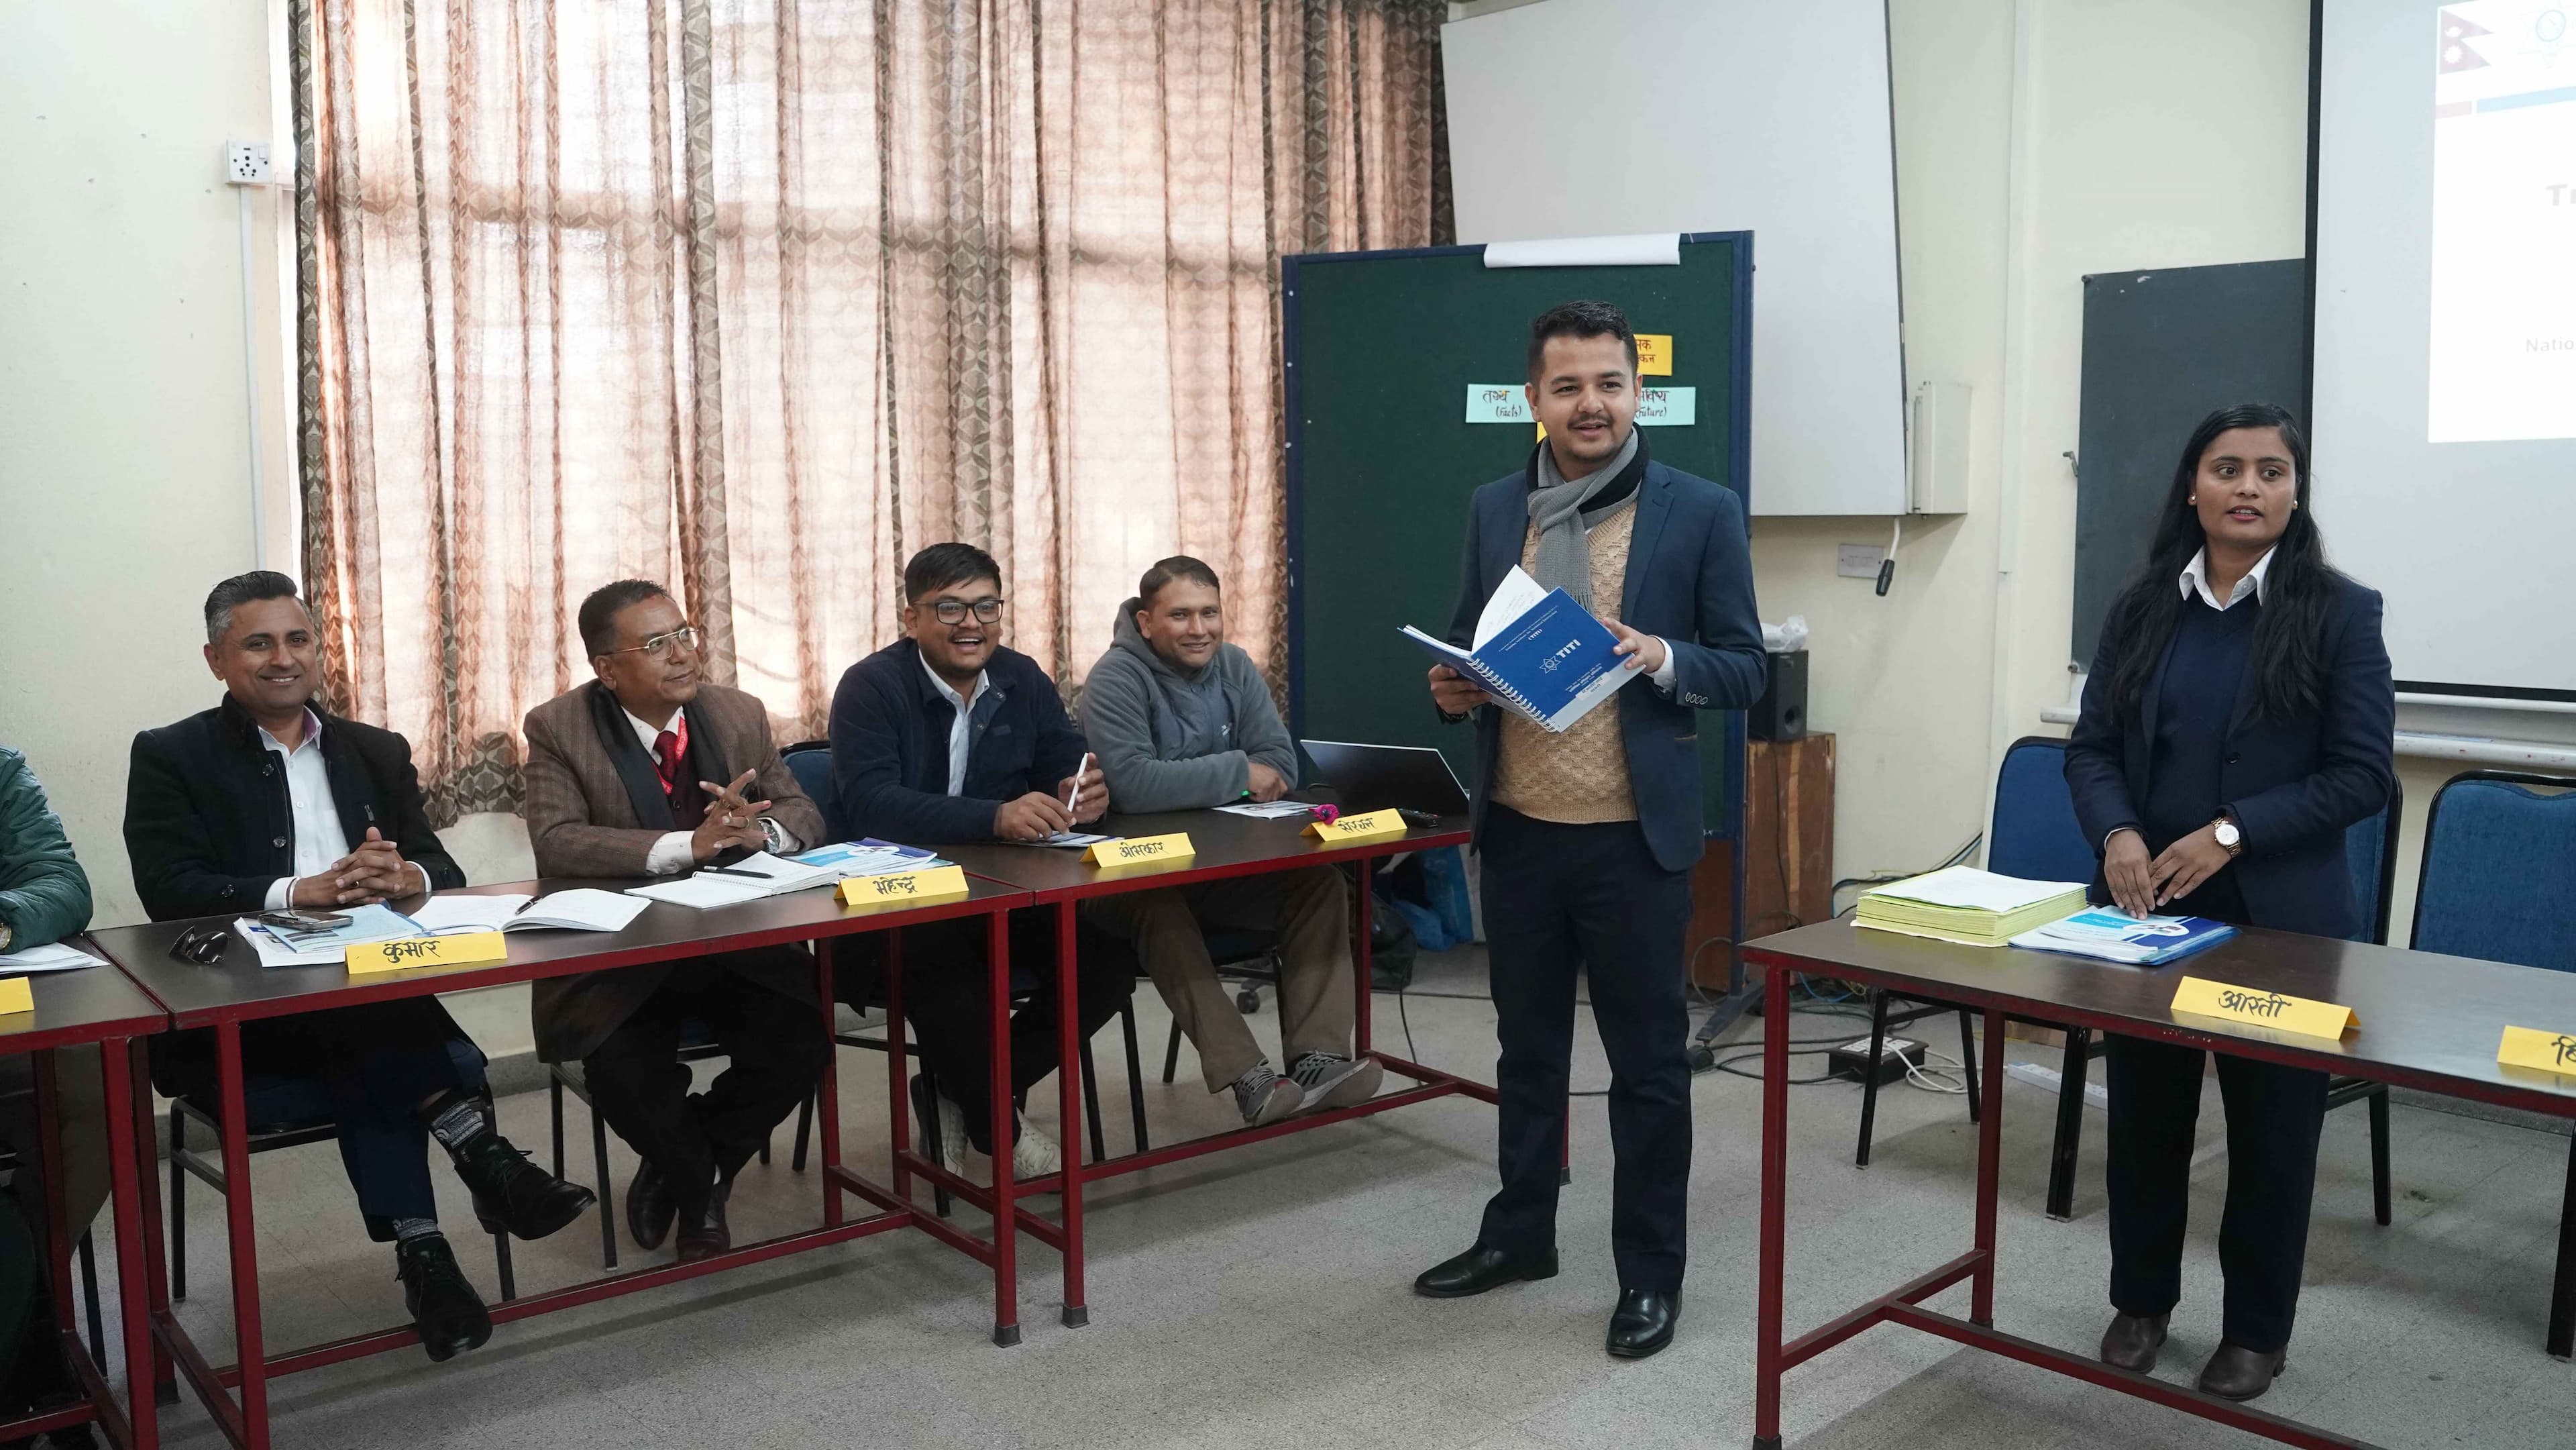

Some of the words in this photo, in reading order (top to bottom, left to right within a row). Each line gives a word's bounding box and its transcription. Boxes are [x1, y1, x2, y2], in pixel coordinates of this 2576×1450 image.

[2526, 335, 2576, 353] Natio
[1556, 639, 1581, 658] TITI
[382, 941, 440, 963] कुमार
[2218, 990, 2292, 1018] आरती
